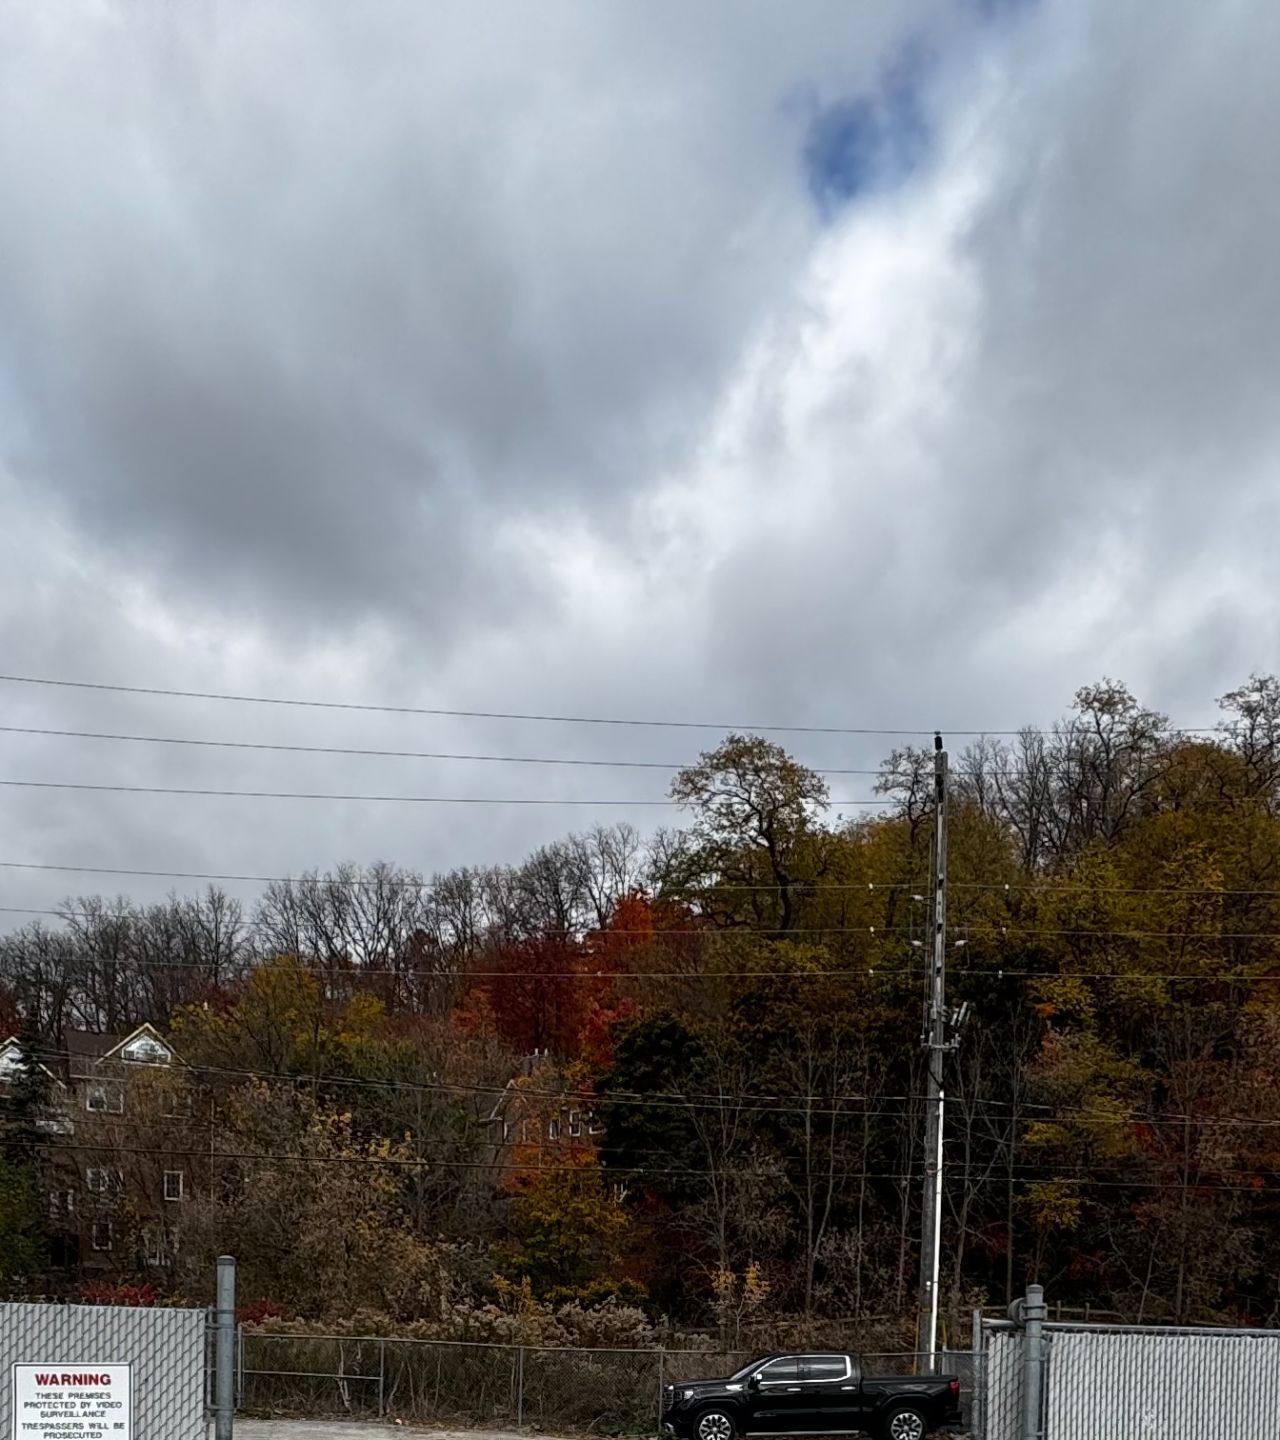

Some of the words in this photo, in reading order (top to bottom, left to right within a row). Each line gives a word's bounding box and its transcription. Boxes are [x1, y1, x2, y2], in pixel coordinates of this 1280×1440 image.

[35, 1374, 111, 1386] WARNING
[21, 1422, 84, 1430] TRESPASSERS
[88, 1422, 109, 1430] WILL
[113, 1422, 125, 1430] BE
